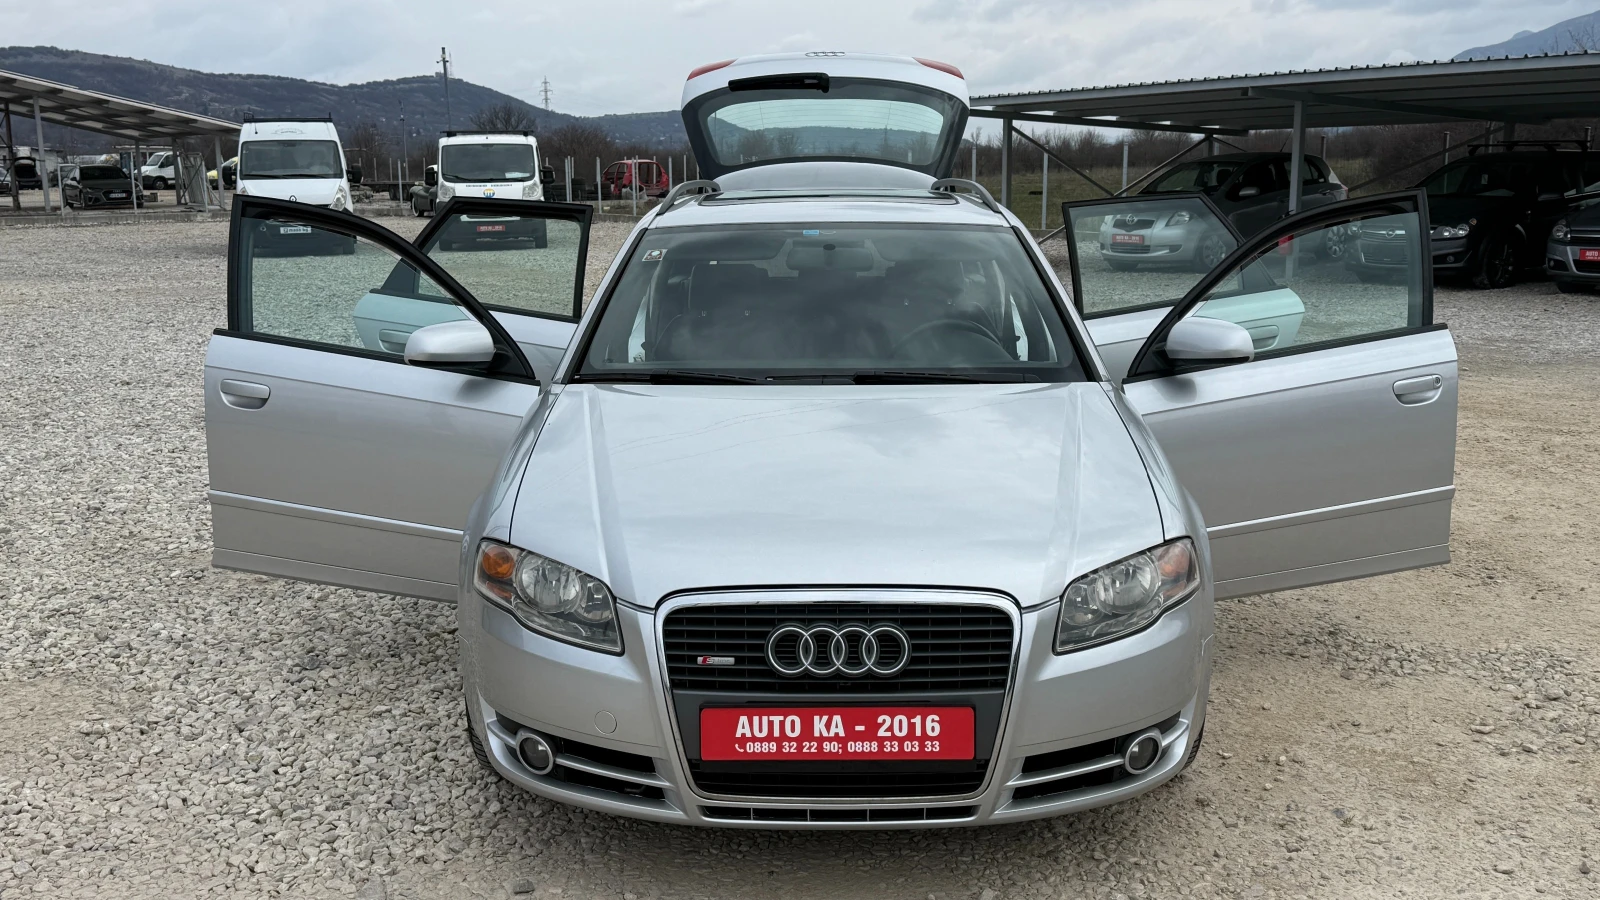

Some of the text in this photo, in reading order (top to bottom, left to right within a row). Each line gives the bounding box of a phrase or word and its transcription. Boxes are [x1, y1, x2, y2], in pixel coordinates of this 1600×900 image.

[735, 715, 801, 738] AUTO
[813, 715, 845, 737] KA
[877, 714, 941, 737] 2016
[746, 740, 940, 755] 0889 32 22 90; 0888 33 03 33
